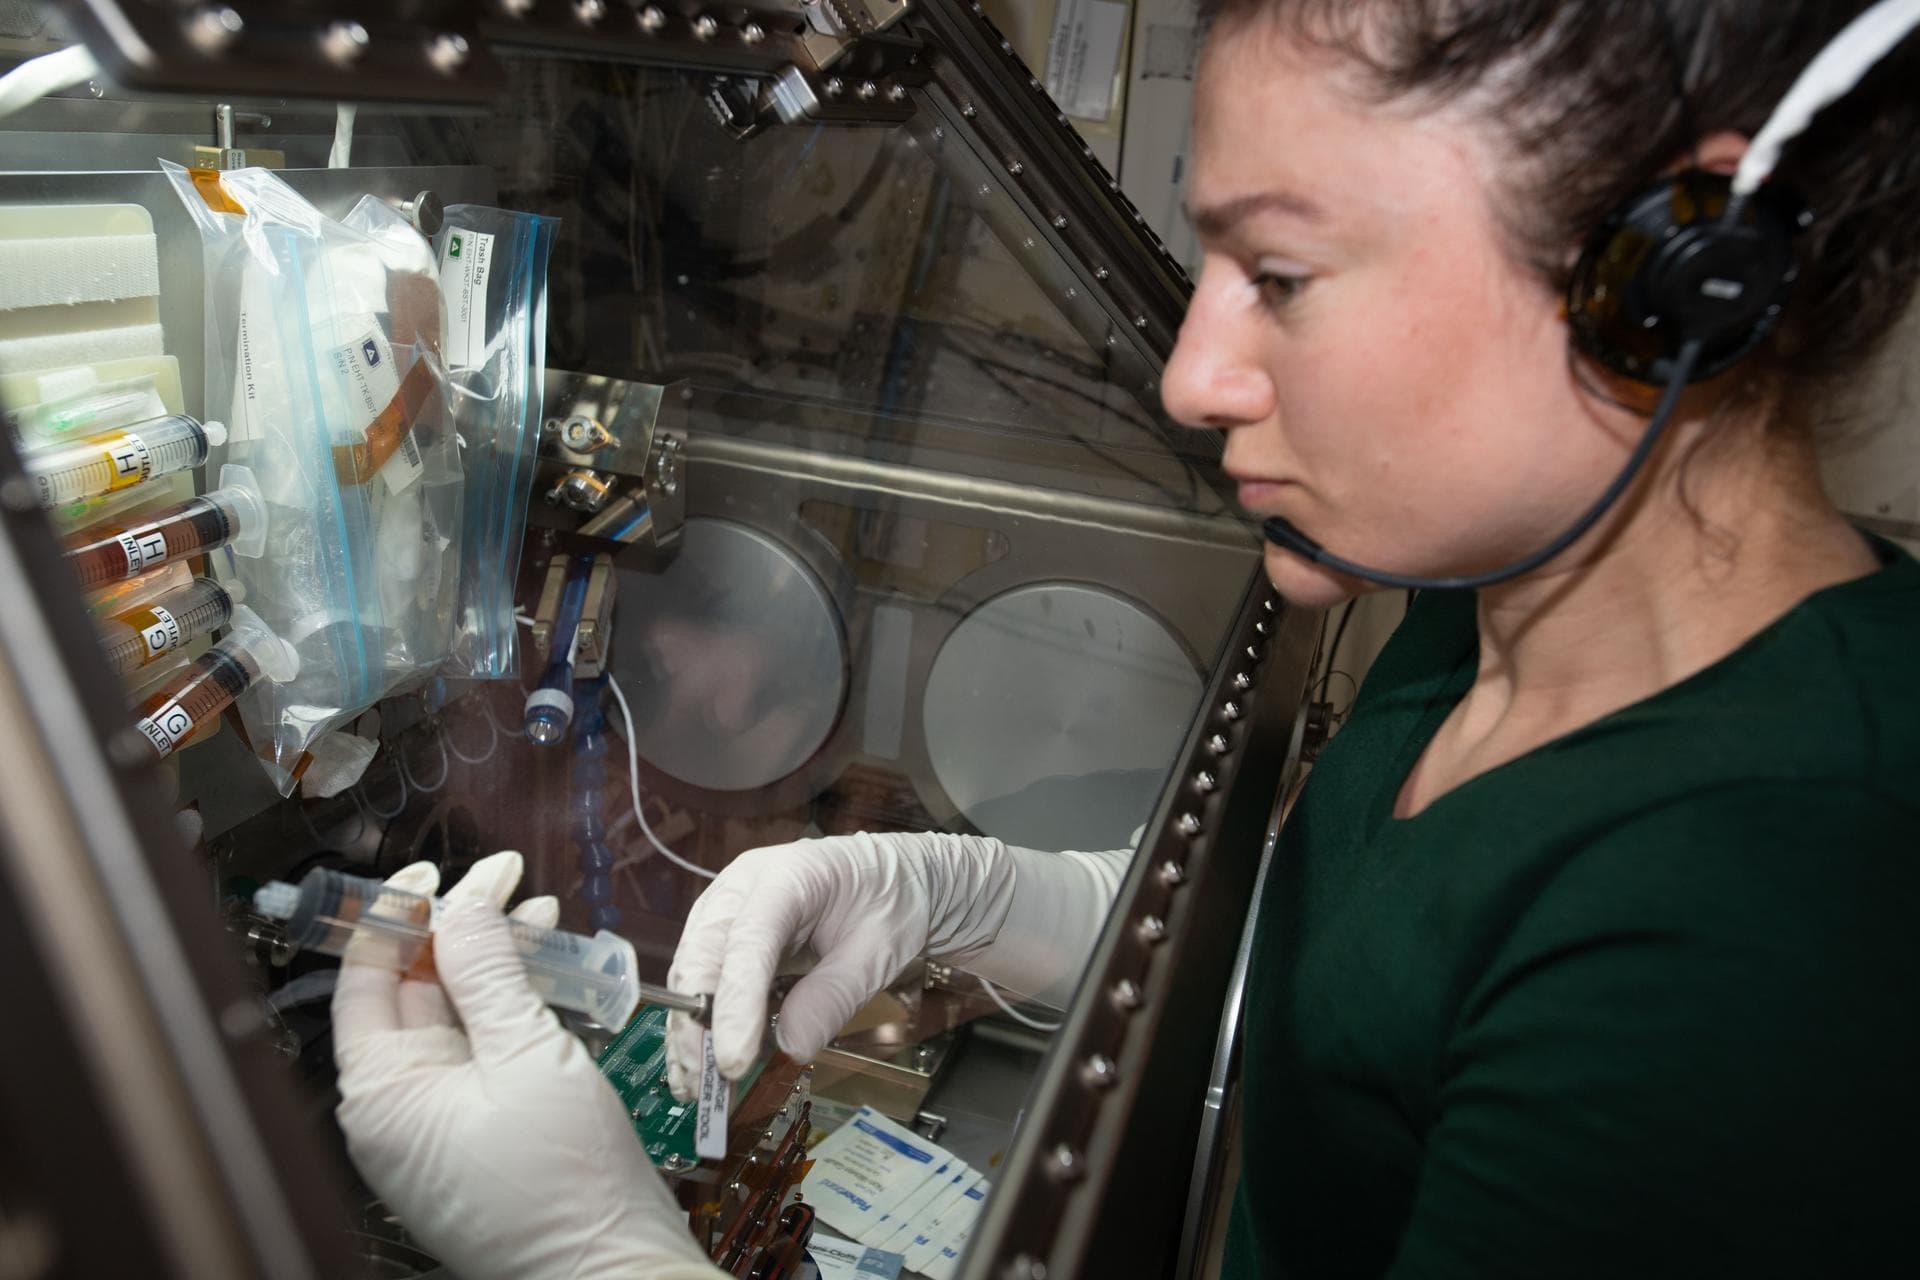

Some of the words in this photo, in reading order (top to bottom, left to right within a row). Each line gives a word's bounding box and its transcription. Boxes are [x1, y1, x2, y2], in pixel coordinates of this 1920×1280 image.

[478, 238, 489, 264] Trash
[473, 266, 485, 285] Bag
[241, 312, 252, 381] Termination
[247, 383, 256, 400] Kit
[334, 351, 345, 367] S/N
[344, 348, 357, 365] P/N
[117, 453, 138, 474] H
[131, 439, 150, 483] OUTLET
[122, 537, 141, 572] INLET
[143, 539, 164, 560] H
[150, 629, 167, 650] G
[167, 713, 187, 735] G
[141, 721, 170, 752] INLET
[699, 1106, 711, 1143] TOOL
